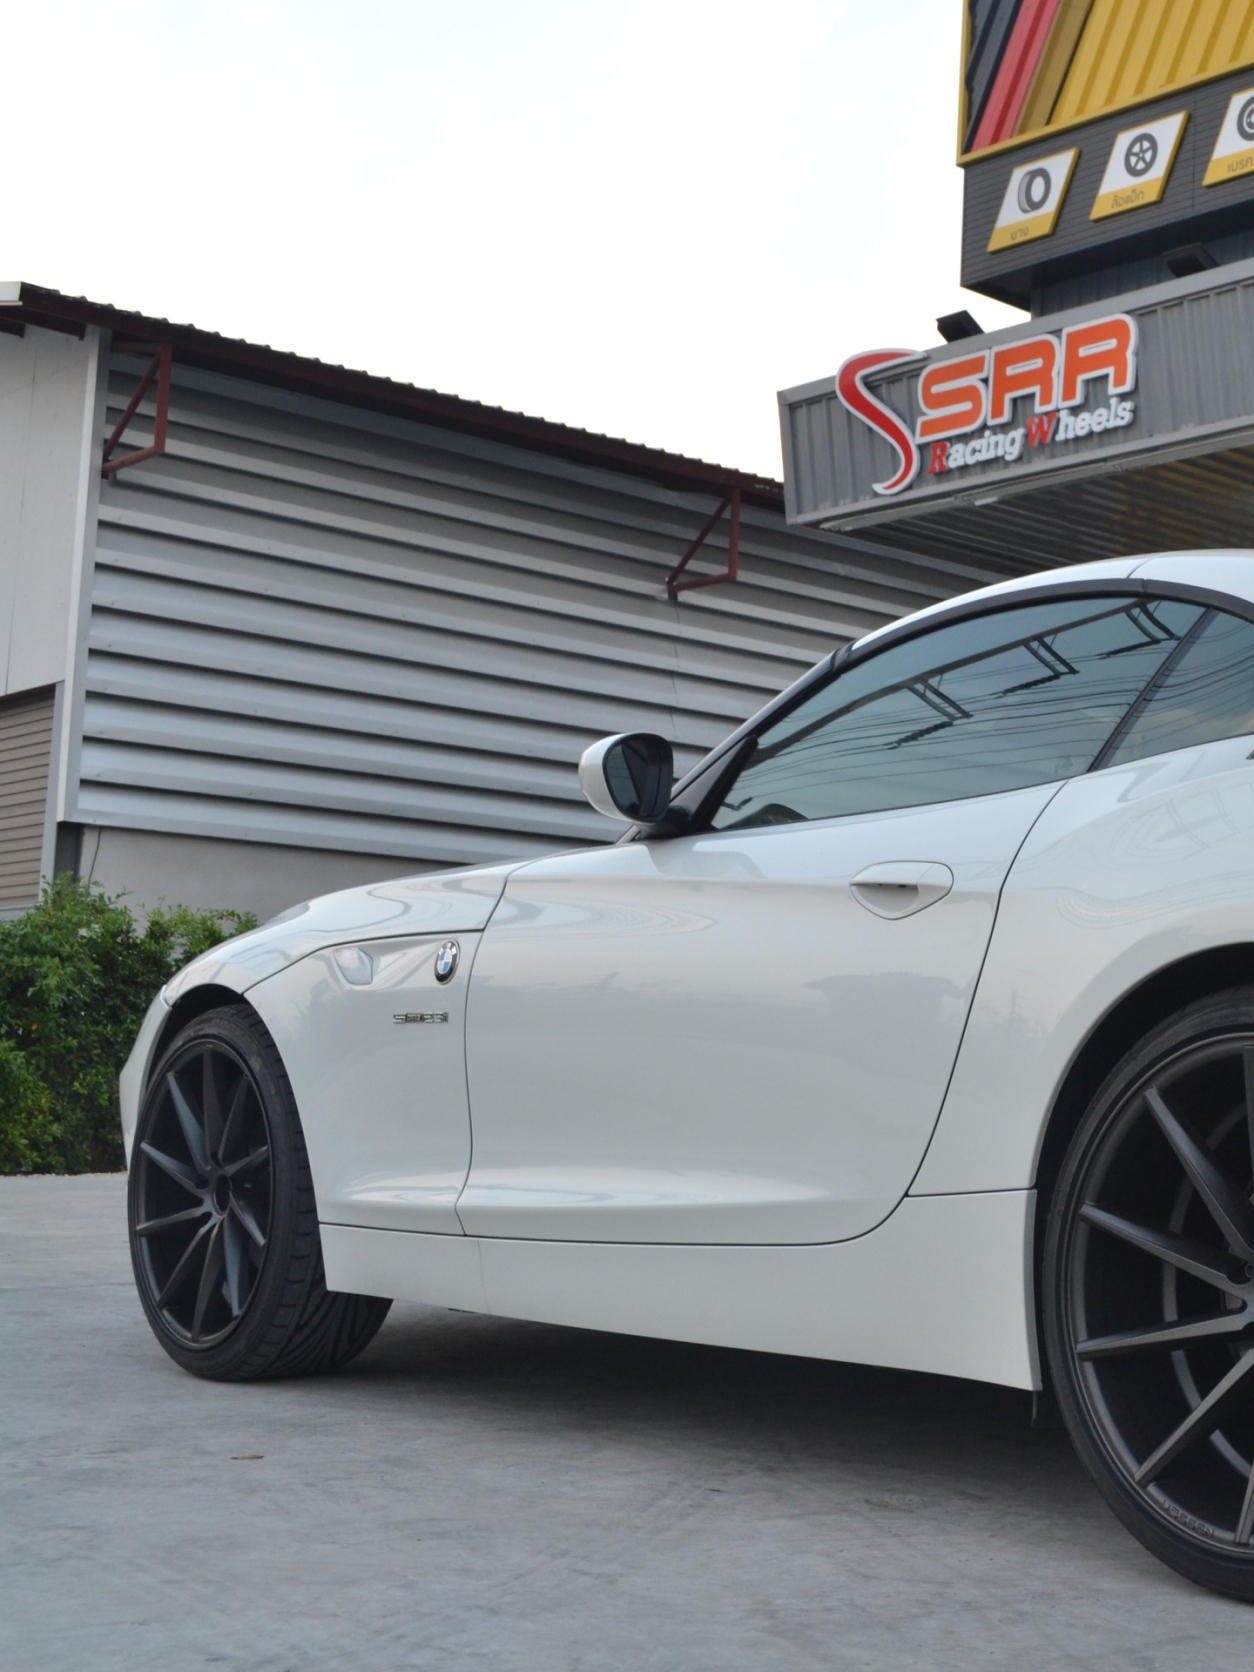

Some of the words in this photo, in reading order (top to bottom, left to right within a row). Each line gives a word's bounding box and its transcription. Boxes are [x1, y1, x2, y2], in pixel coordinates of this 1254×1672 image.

[1227, 156, 1254, 174] เบรค
[1010, 226, 1030, 241] ยาง
[927, 425, 1026, 474] Racing
[1025, 397, 1135, 449] Wheels
